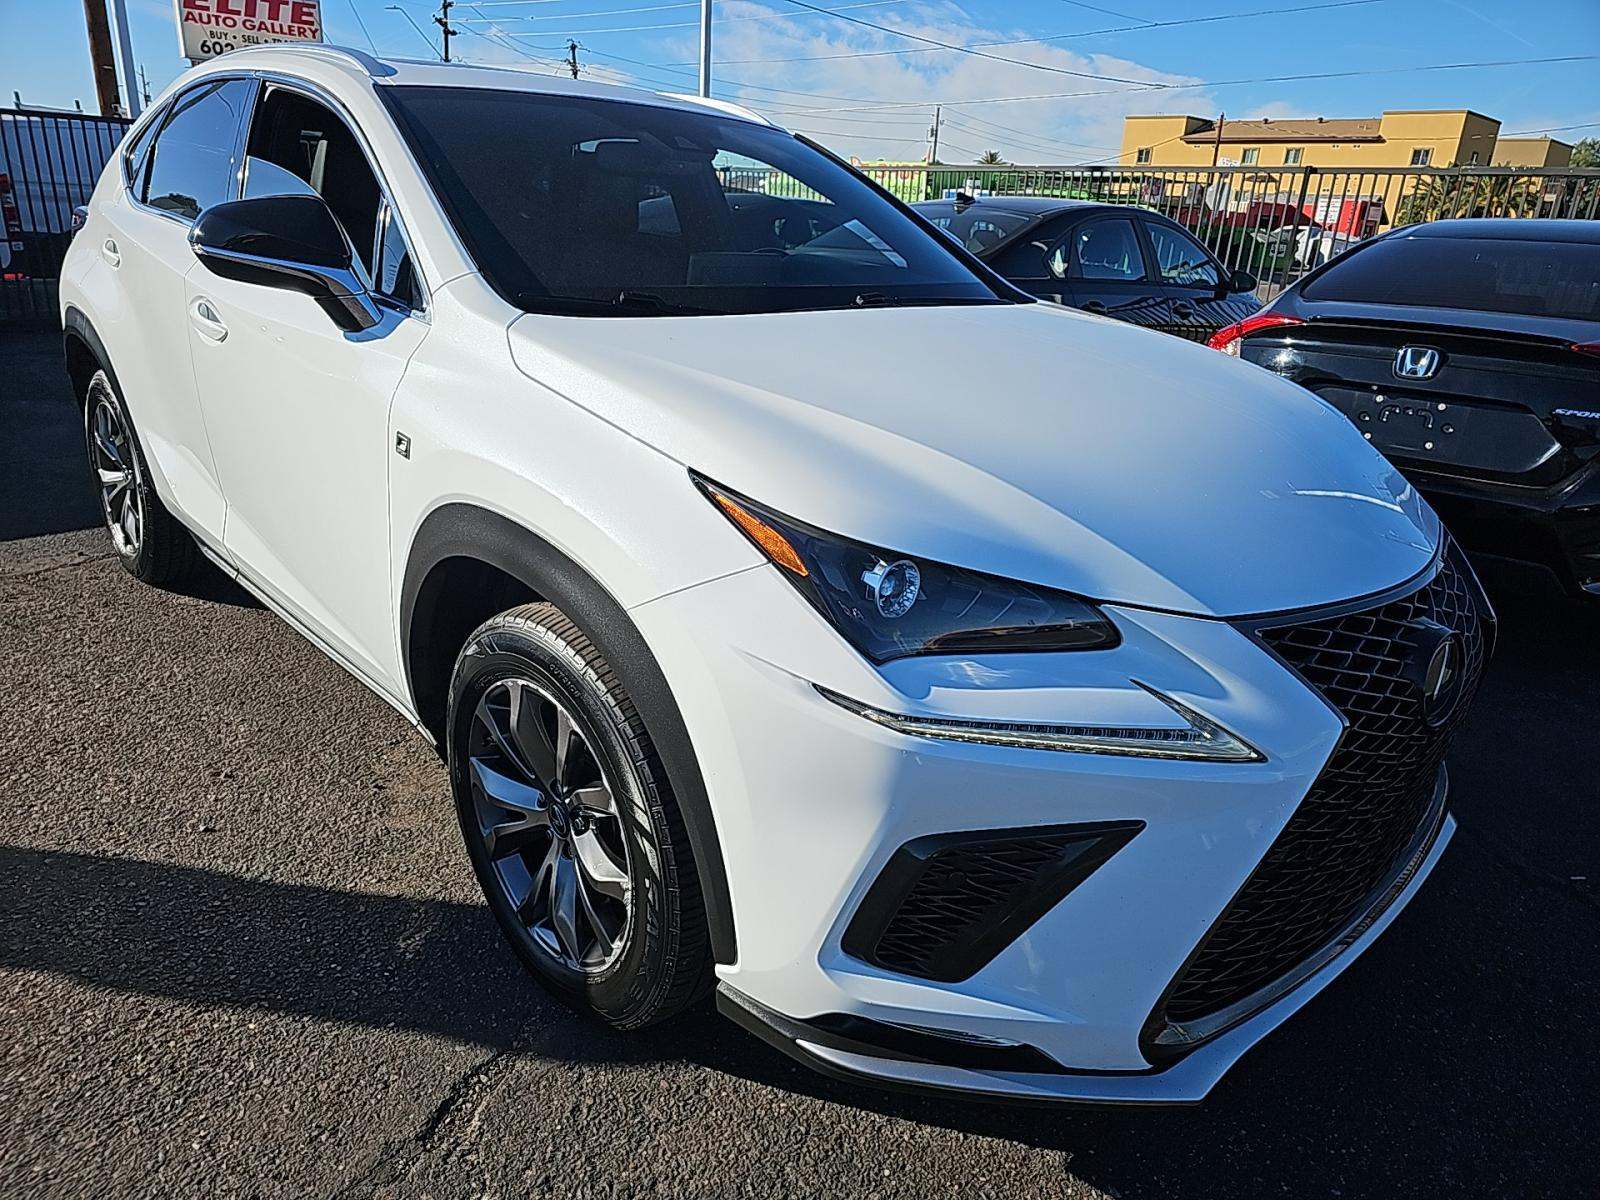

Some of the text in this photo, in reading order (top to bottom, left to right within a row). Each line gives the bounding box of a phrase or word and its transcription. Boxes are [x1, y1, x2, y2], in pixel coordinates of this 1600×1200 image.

[183, 10, 320, 39] AUTO GALLERY
[209, 30, 229, 40] BUY
[241, 34, 261, 44] SELL
